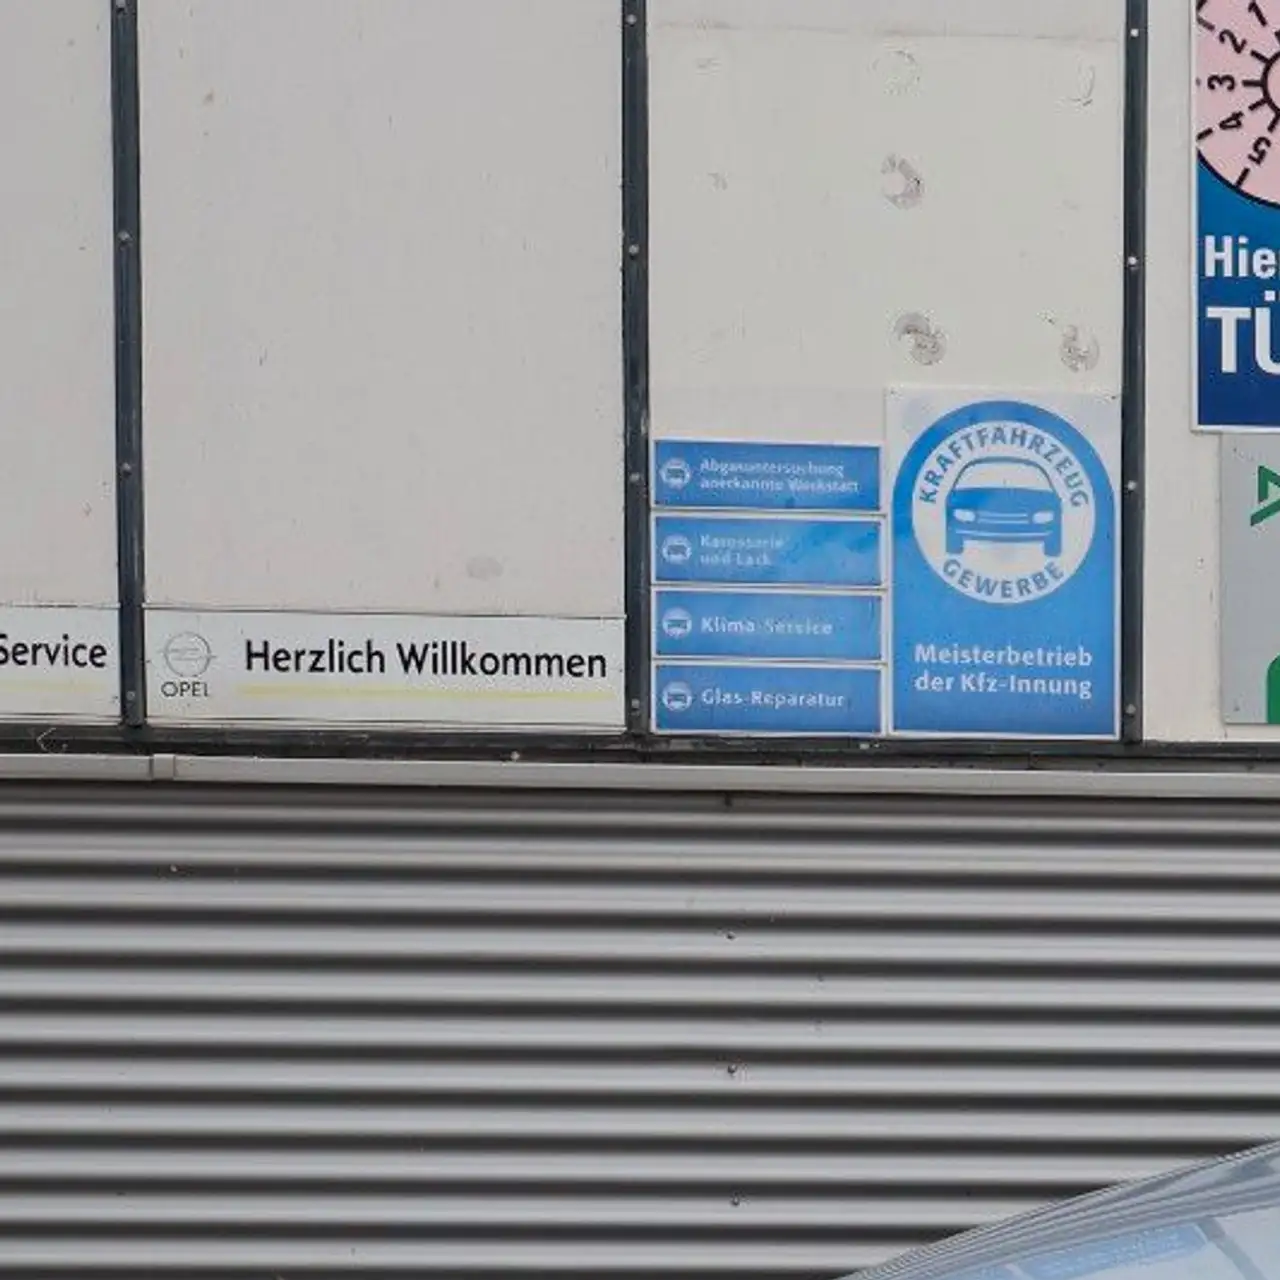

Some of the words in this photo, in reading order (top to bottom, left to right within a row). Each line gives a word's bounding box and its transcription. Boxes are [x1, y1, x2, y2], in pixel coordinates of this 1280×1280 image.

[1248, 1, 1267, 27] 1
[1218, 29, 1247, 54] 2
[1207, 74, 1236, 91] 3
[1219, 111, 1244, 130] 4
[1247, 136, 1272, 165] 5
[919, 426, 1089, 508] KRAFTFAHRZEUG
[700, 551, 730, 566] und
[736, 551, 772, 566] Lack
[943, 558, 1064, 599] GEWERBE
[245, 638, 386, 673] Herzlich
[396, 641, 607, 678] Willkommen
[914, 644, 1092, 667] Meisterbetrieb
[161, 680, 209, 698] OPEL
[914, 670, 955, 692] der
[961, 672, 1092, 700] Kfz-Innung
